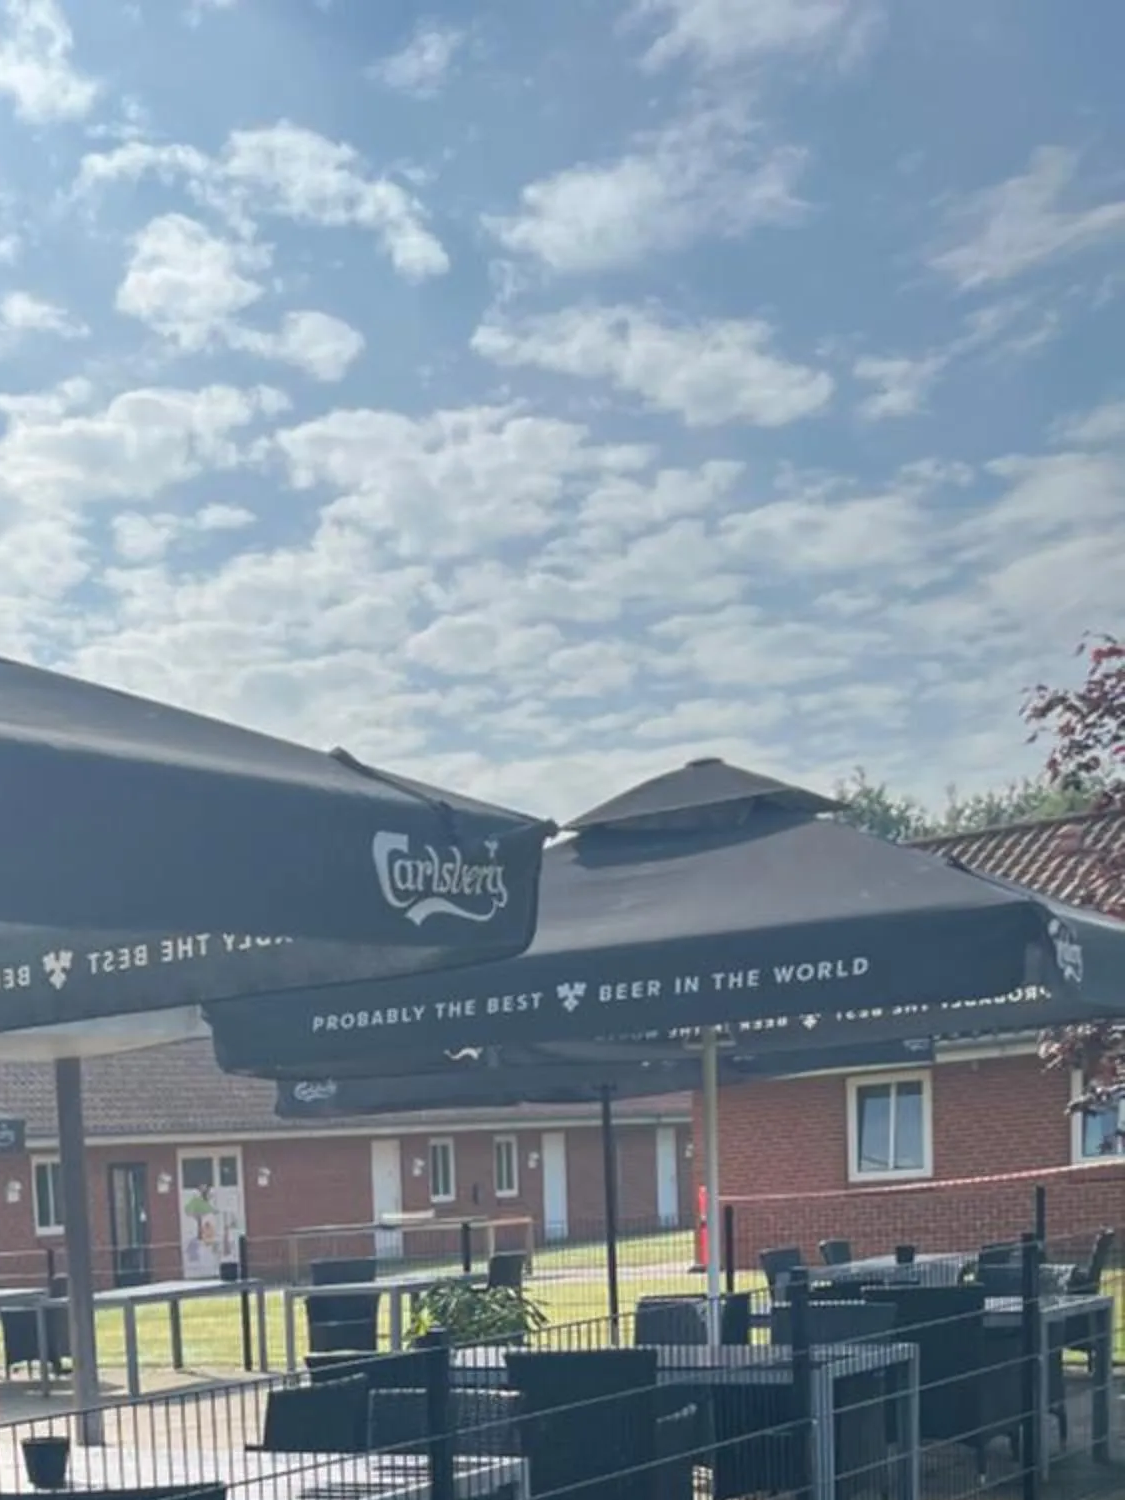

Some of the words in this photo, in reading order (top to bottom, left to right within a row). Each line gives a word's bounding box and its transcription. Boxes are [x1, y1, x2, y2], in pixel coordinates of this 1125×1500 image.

[372, 830, 509, 926] Carlsberg
[312, 1006, 425, 1033] PROBABLY
[435, 1000, 476, 1020] THE
[487, 992, 544, 1015] BEST
[599, 980, 662, 1002] BEER
[675, 976, 700, 995] IN
[712, 969, 761, 991] THE
[774, 957, 870, 984] WORLD
